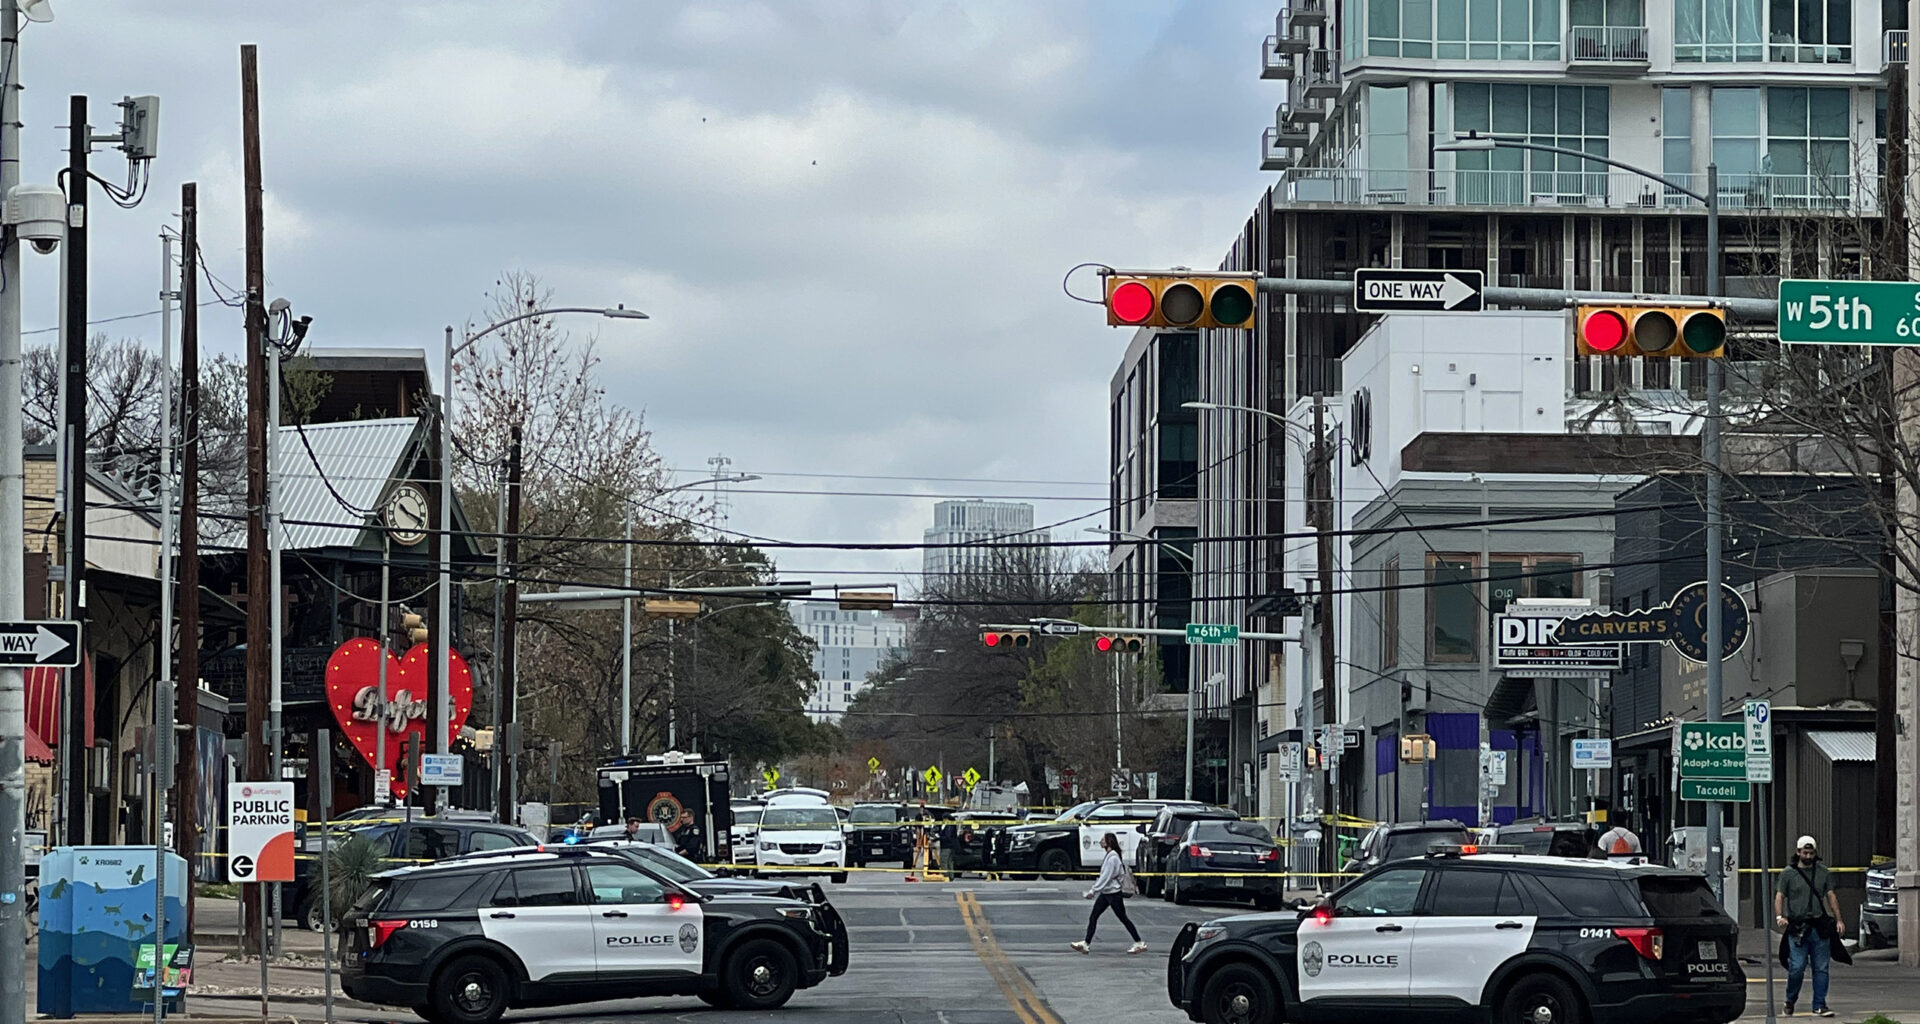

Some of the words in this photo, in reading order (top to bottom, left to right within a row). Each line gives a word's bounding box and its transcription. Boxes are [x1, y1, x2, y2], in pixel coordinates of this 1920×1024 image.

[1369, 282, 1403, 298] ONE
[1409, 283, 1444, 299] WAY
[1786, 301, 1804, 322] W
[1808, 295, 1872, 330] 5th
[1675, 588, 1705, 616] OYSTE
[1200, 626, 1221, 637] 6th
[1502, 618, 1561, 645] DIR
[1579, 620, 1667, 636] CARVER'S
[2, 635, 37, 652] WAY
[1706, 731, 1747, 749] kab
[1695, 784, 1736, 796] Tacodeli
[232, 800, 290, 813] PUBLIC
[232, 814, 290, 825] PARKING
[410, 919, 438, 929] 0158
[1579, 927, 1611, 938] 0141
[606, 935, 674, 945] POLICE
[1327, 954, 1399, 965] POLICE
[1687, 963, 1729, 973] POLICE
